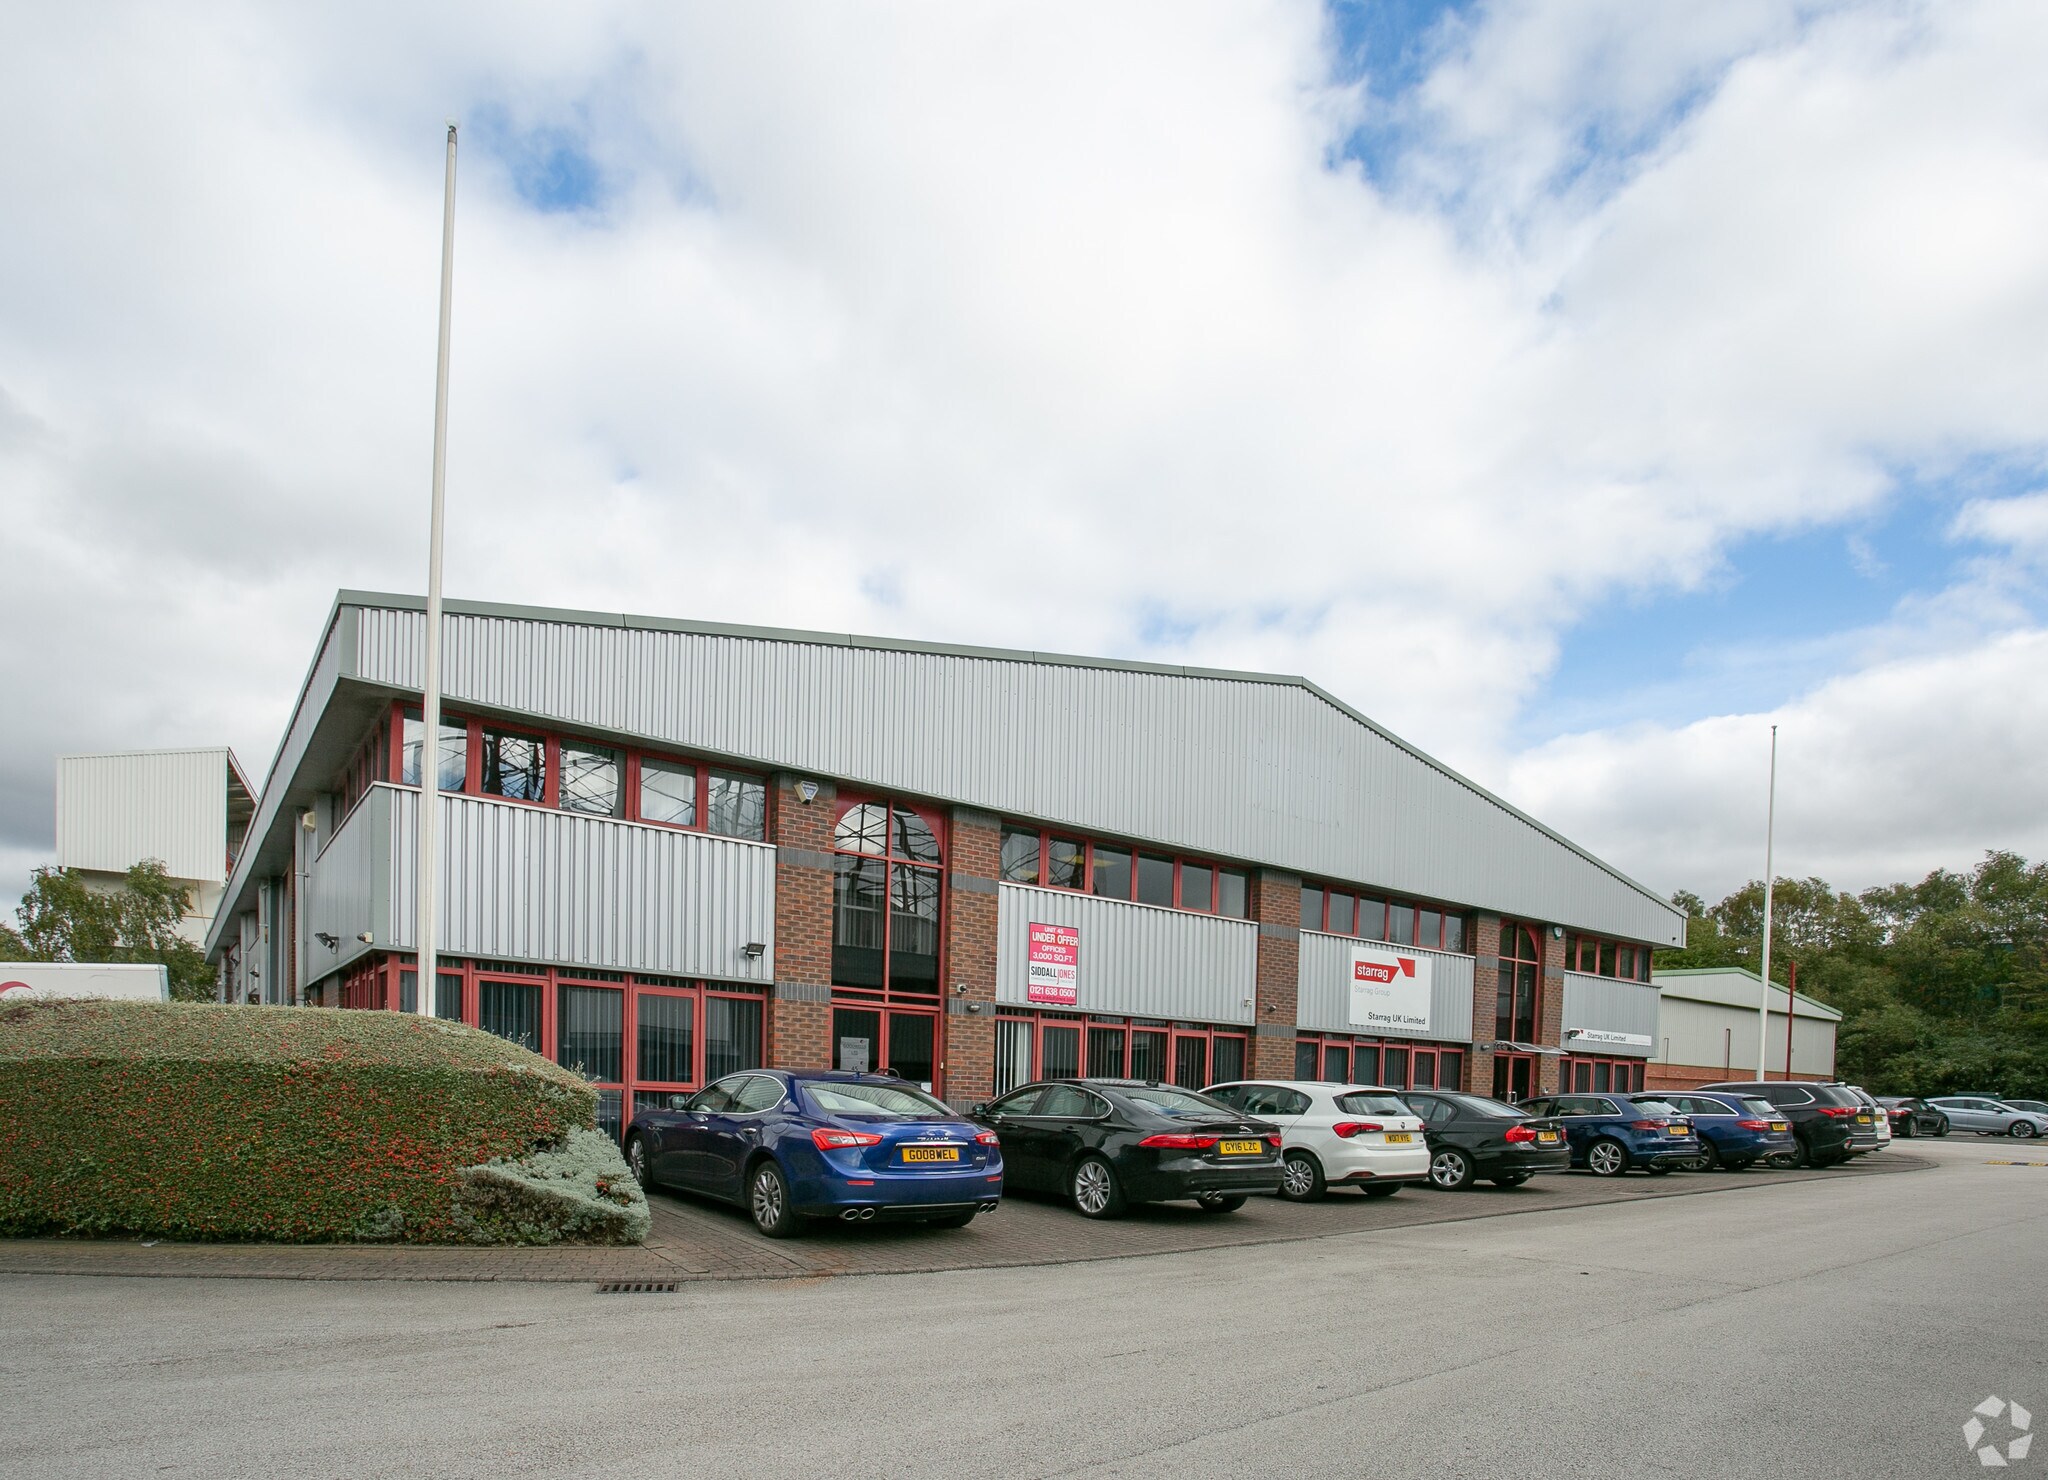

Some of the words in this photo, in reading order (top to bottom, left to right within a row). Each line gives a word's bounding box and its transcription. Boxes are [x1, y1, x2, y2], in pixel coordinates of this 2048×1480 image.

[1032, 931, 1055, 943] UNDER
[1057, 935, 1078, 946] OFFER
[1042, 945, 1066, 953] OFFICES
[1033, 952, 1052, 960] 3,000
[1031, 966, 1057, 977] SIDDALL
[1057, 969, 1076, 985] JONES
[1357, 965, 1388, 980] starrag
[1030, 986, 1044, 994] 0121
[1045, 988, 1058, 996] 638
[1059, 989, 1075, 997] 0500
[1354, 985, 1374, 995] Starrag
[1375, 988, 1390, 996] Group
[1368, 1012, 1391, 1023] Starrag
[1393, 1014, 1402, 1022] UK
[1404, 1015, 1426, 1024] Limited
[1587, 1032, 1602, 1040] Starrag
[1225, 1142, 1243, 1152] GY16
[1243, 1142, 1258, 1151] LZC
